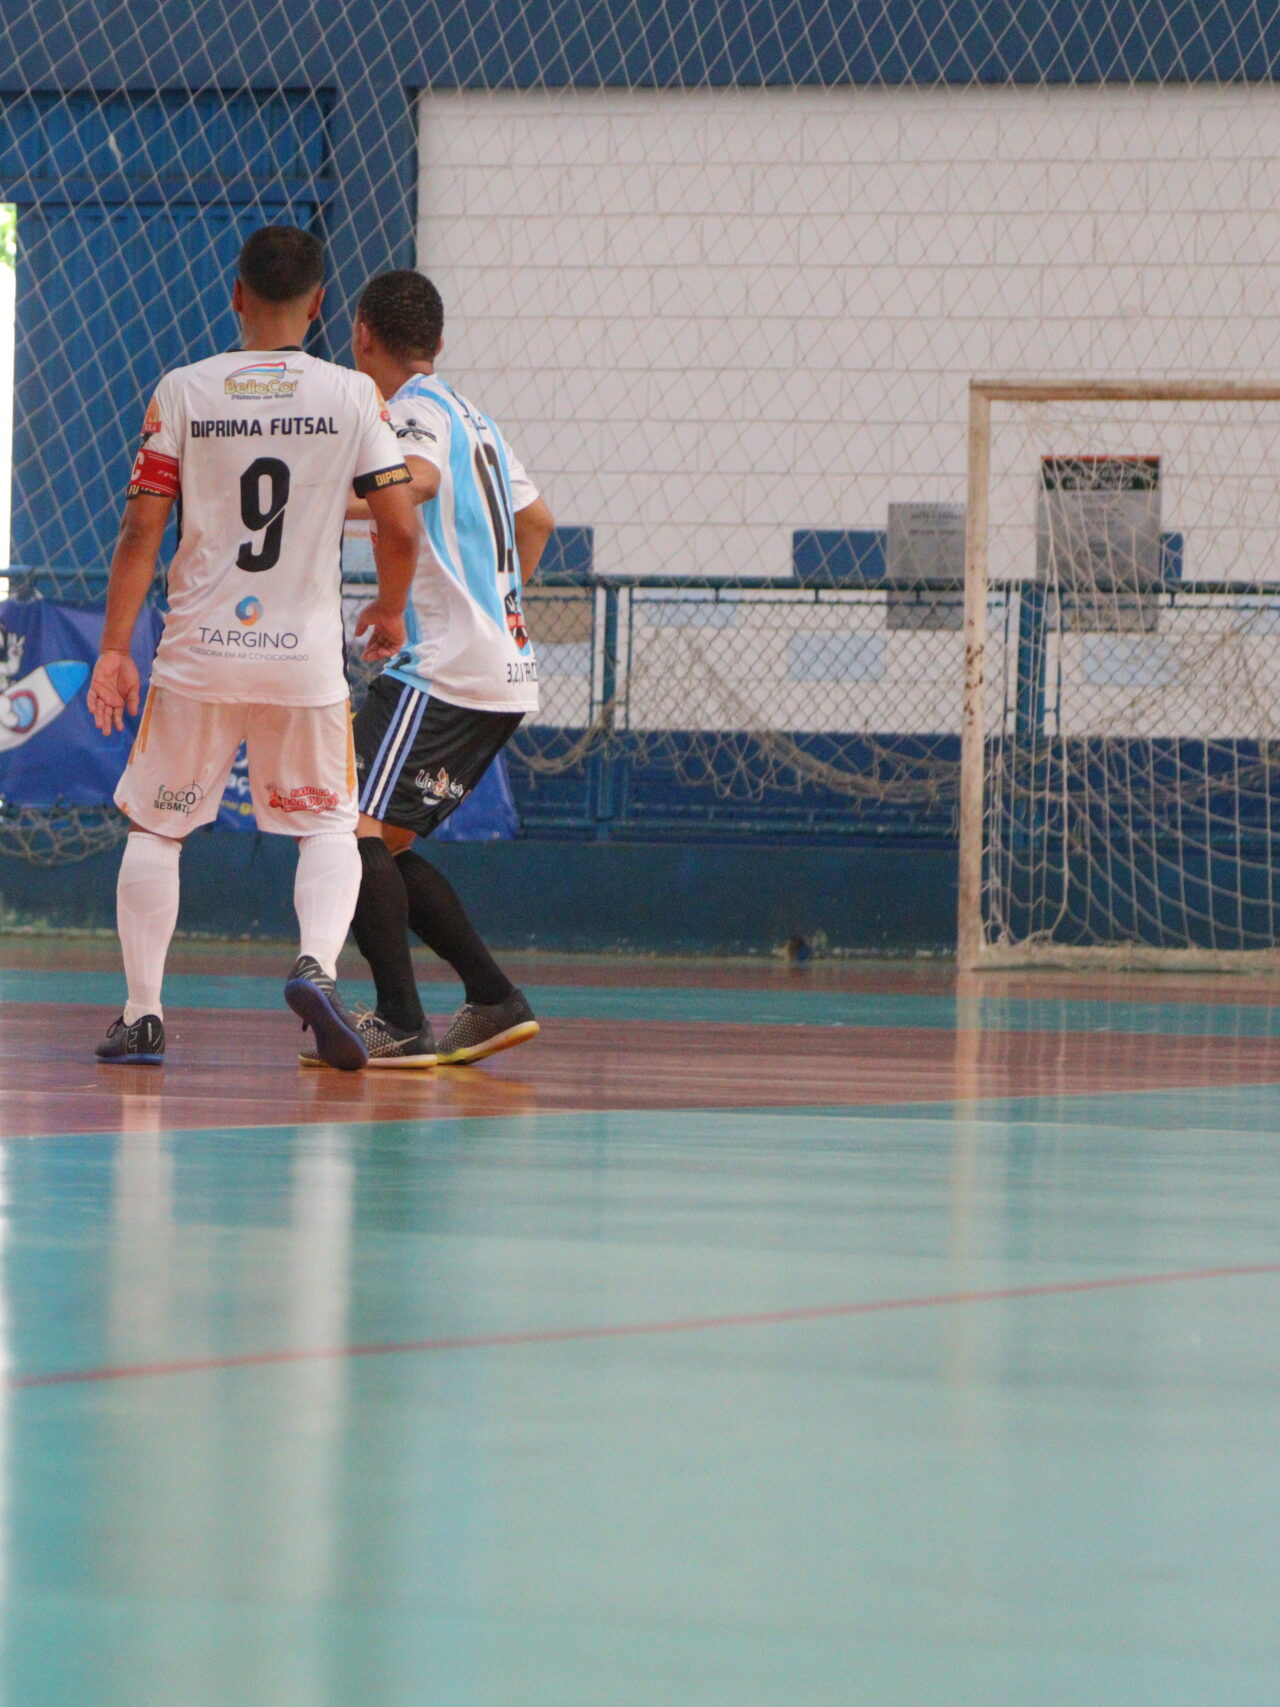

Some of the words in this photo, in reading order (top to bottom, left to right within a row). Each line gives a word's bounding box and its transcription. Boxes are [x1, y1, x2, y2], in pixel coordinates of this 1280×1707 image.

[191, 419, 263, 438] DIPRIMA
[270, 416, 339, 436] FUTSAL
[236, 457, 290, 572] 9
[198, 627, 299, 649] TARGINO
[158, 784, 196, 805] foco
[154, 800, 188, 812] SESMT
